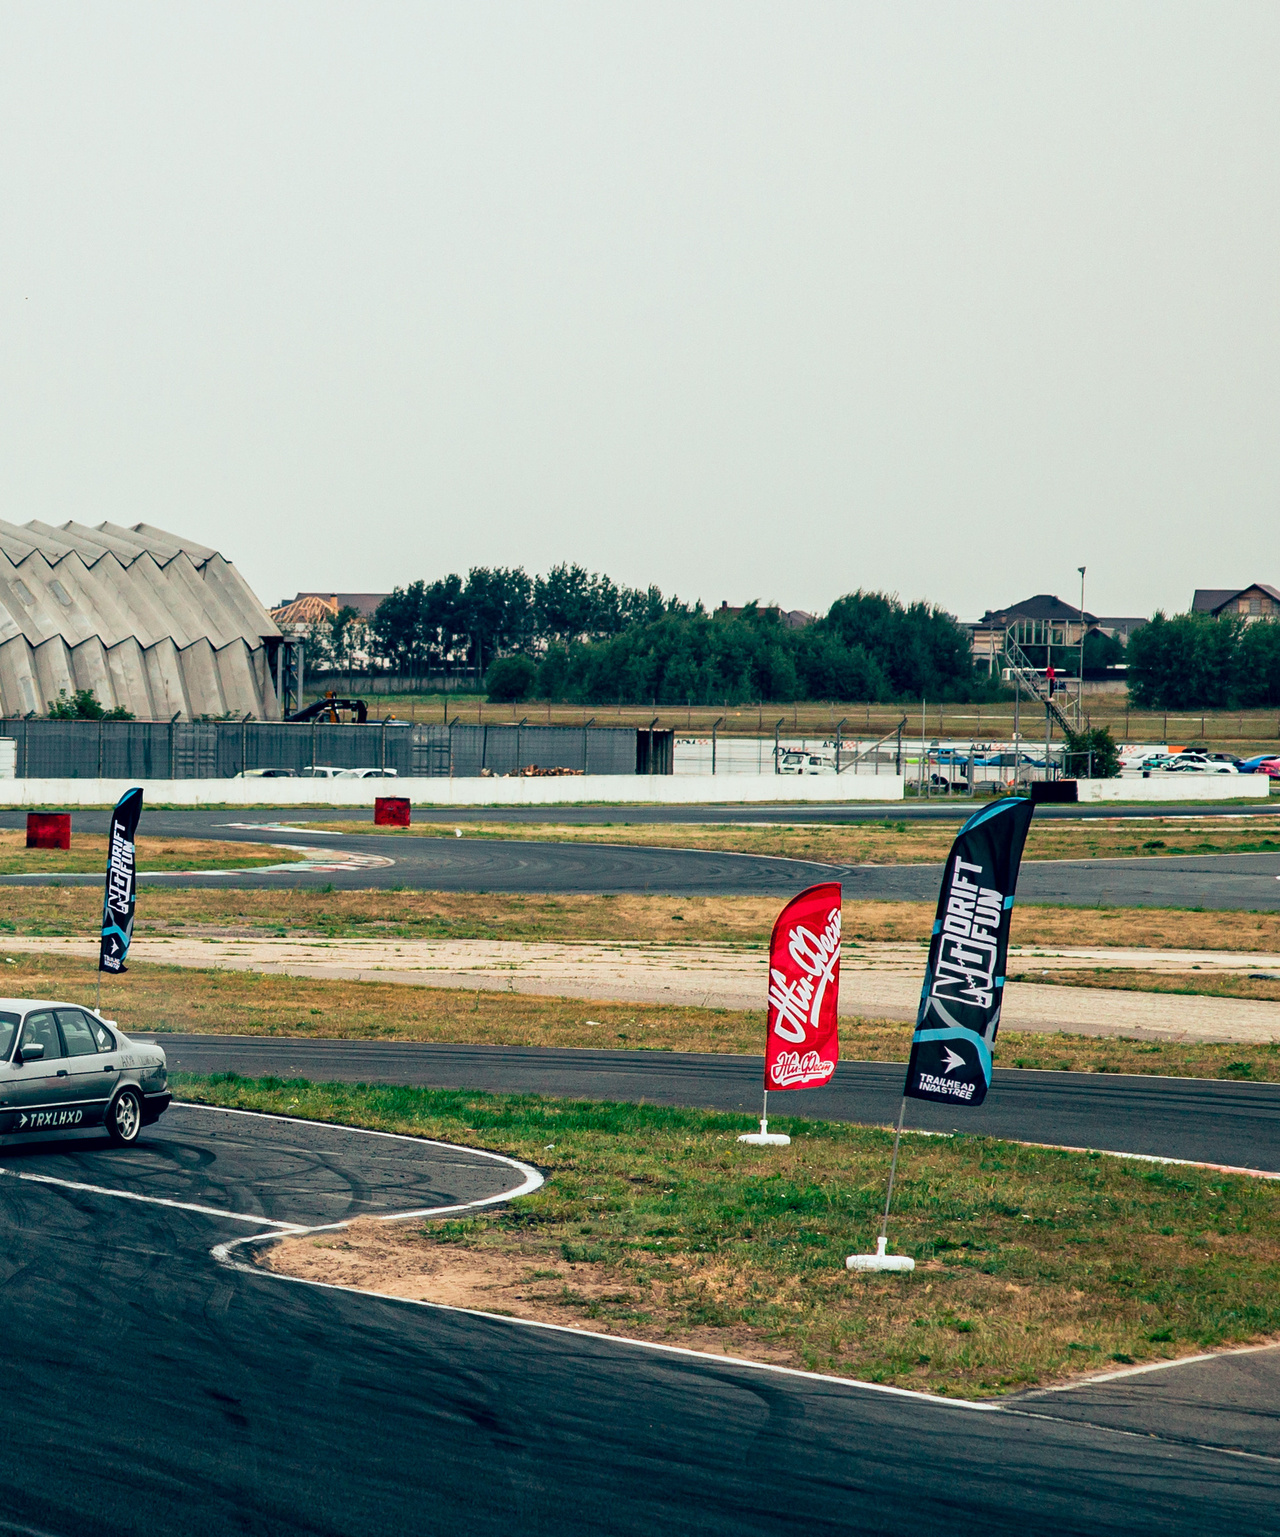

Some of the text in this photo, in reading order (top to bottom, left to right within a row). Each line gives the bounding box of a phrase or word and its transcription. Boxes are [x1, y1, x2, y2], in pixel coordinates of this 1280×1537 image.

[111, 819, 126, 870] DRIFT
[120, 839, 134, 875] FUN
[943, 855, 983, 938] DRIFT
[970, 887, 1004, 945] FUN
[918, 1081, 973, 1100] INDASTREE
[920, 1072, 976, 1092] TRAILHEAD
[29, 1109, 83, 1128] TRXLHXD
